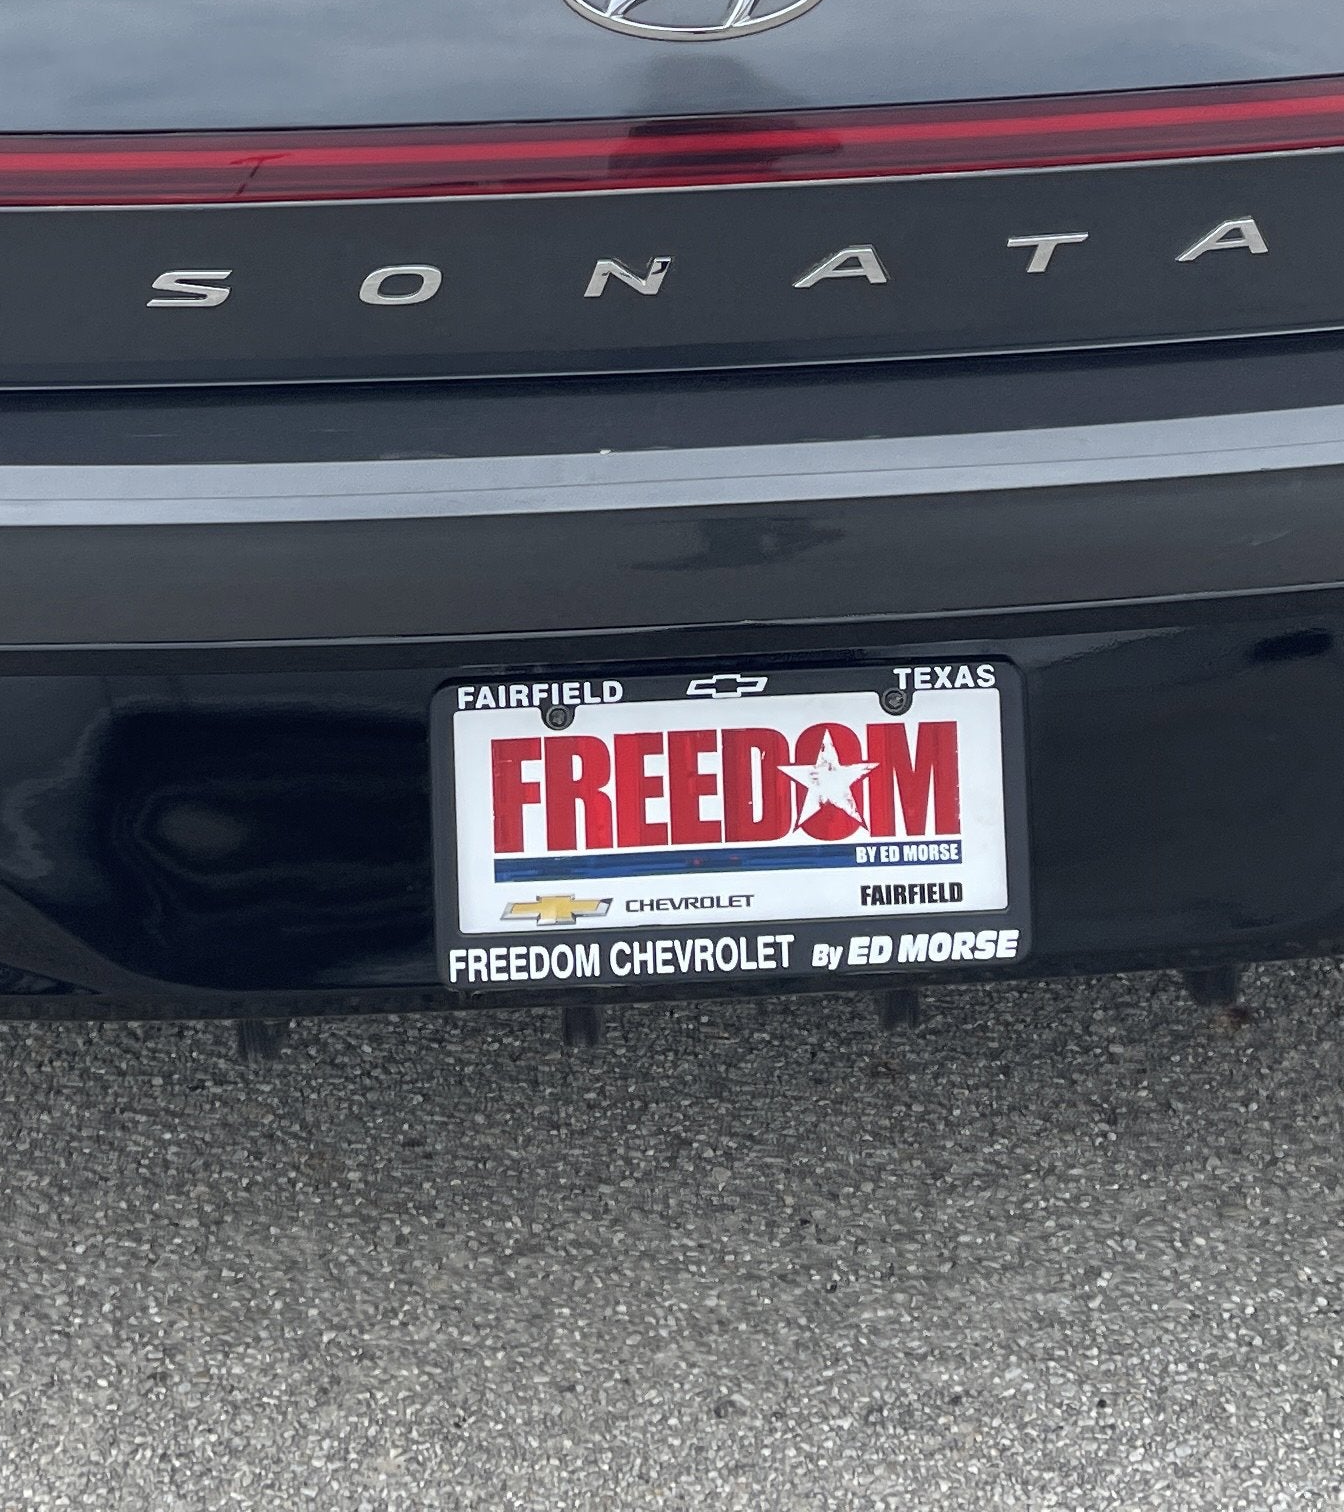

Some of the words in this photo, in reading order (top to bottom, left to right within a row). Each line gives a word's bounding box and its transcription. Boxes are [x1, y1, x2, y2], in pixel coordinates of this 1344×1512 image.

[145, 215, 1270, 308] SONATA
[458, 680, 623, 709] FAIRFIELD
[893, 664, 995, 689] TEXAS
[491, 721, 961, 853] FREEDOM
[856, 846, 877, 863] BY
[880, 845, 900, 862] ED
[903, 843, 959, 862] MORSE
[625, 894, 754, 912] CHEVROLET
[861, 882, 963, 906] FAIRFIELD
[449, 943, 601, 983] FREEDOM
[609, 934, 795, 977] CHEVROLET
[811, 943, 843, 970] By
[847, 935, 892, 965] ED
[897, 929, 1020, 963] MORSE
